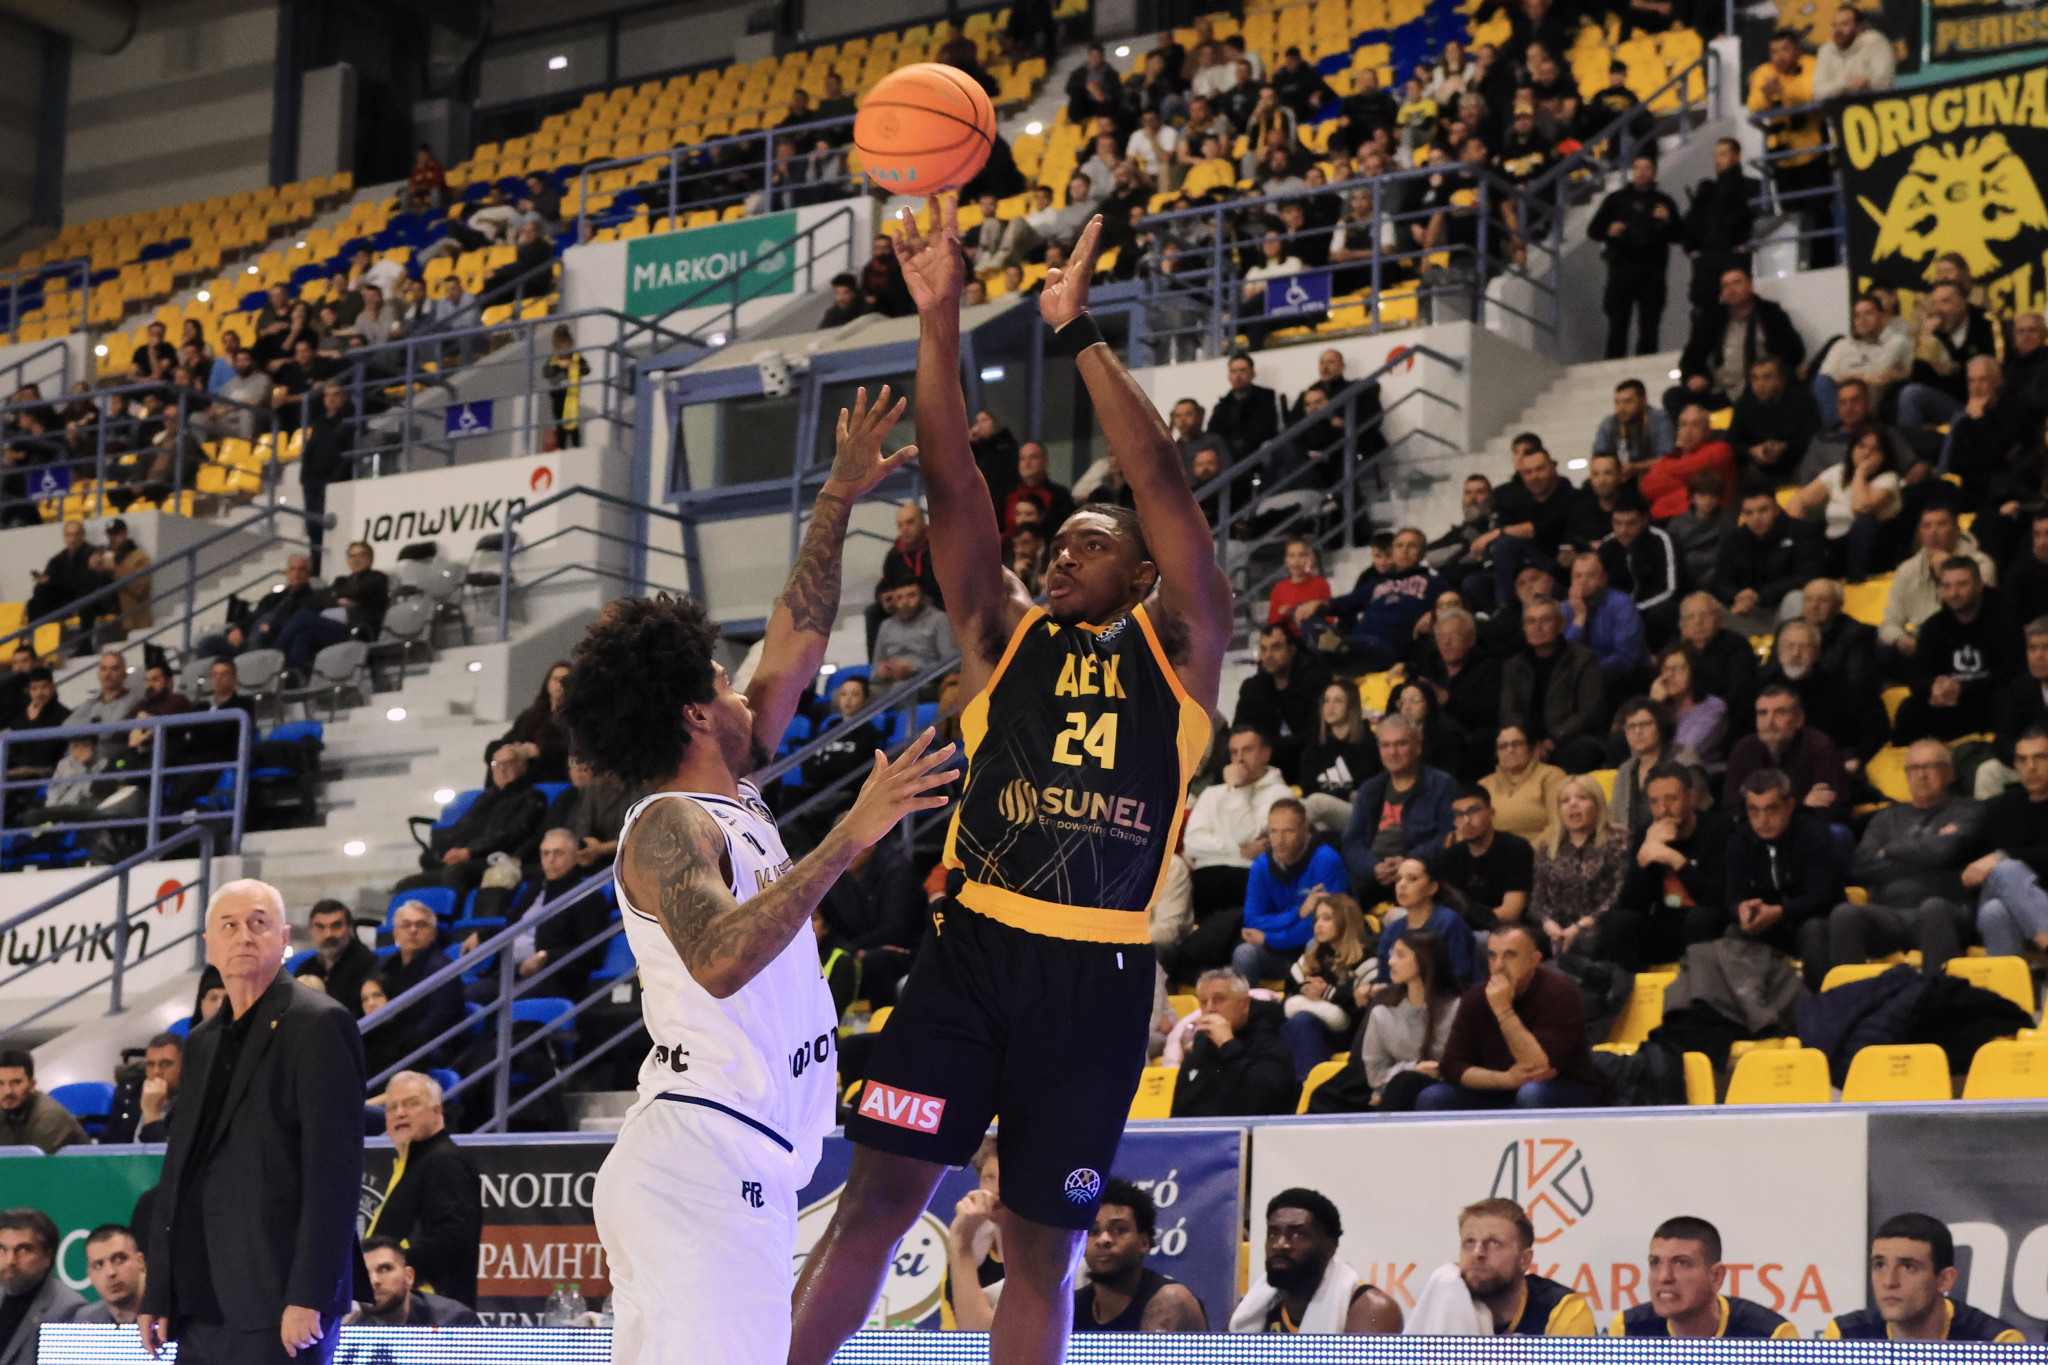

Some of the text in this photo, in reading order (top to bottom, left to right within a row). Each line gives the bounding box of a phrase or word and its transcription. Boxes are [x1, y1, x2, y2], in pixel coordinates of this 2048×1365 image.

[1054, 652, 1127, 699] AEK
[1052, 711, 1118, 770] 24
[1041, 786, 1151, 833] SUNEL
[1109, 827, 1148, 846] Change
[0, 920, 150, 966] ωνικη
[861, 1086, 942, 1129] AVIS
[1526, 1262, 1833, 1314] ARTSA
